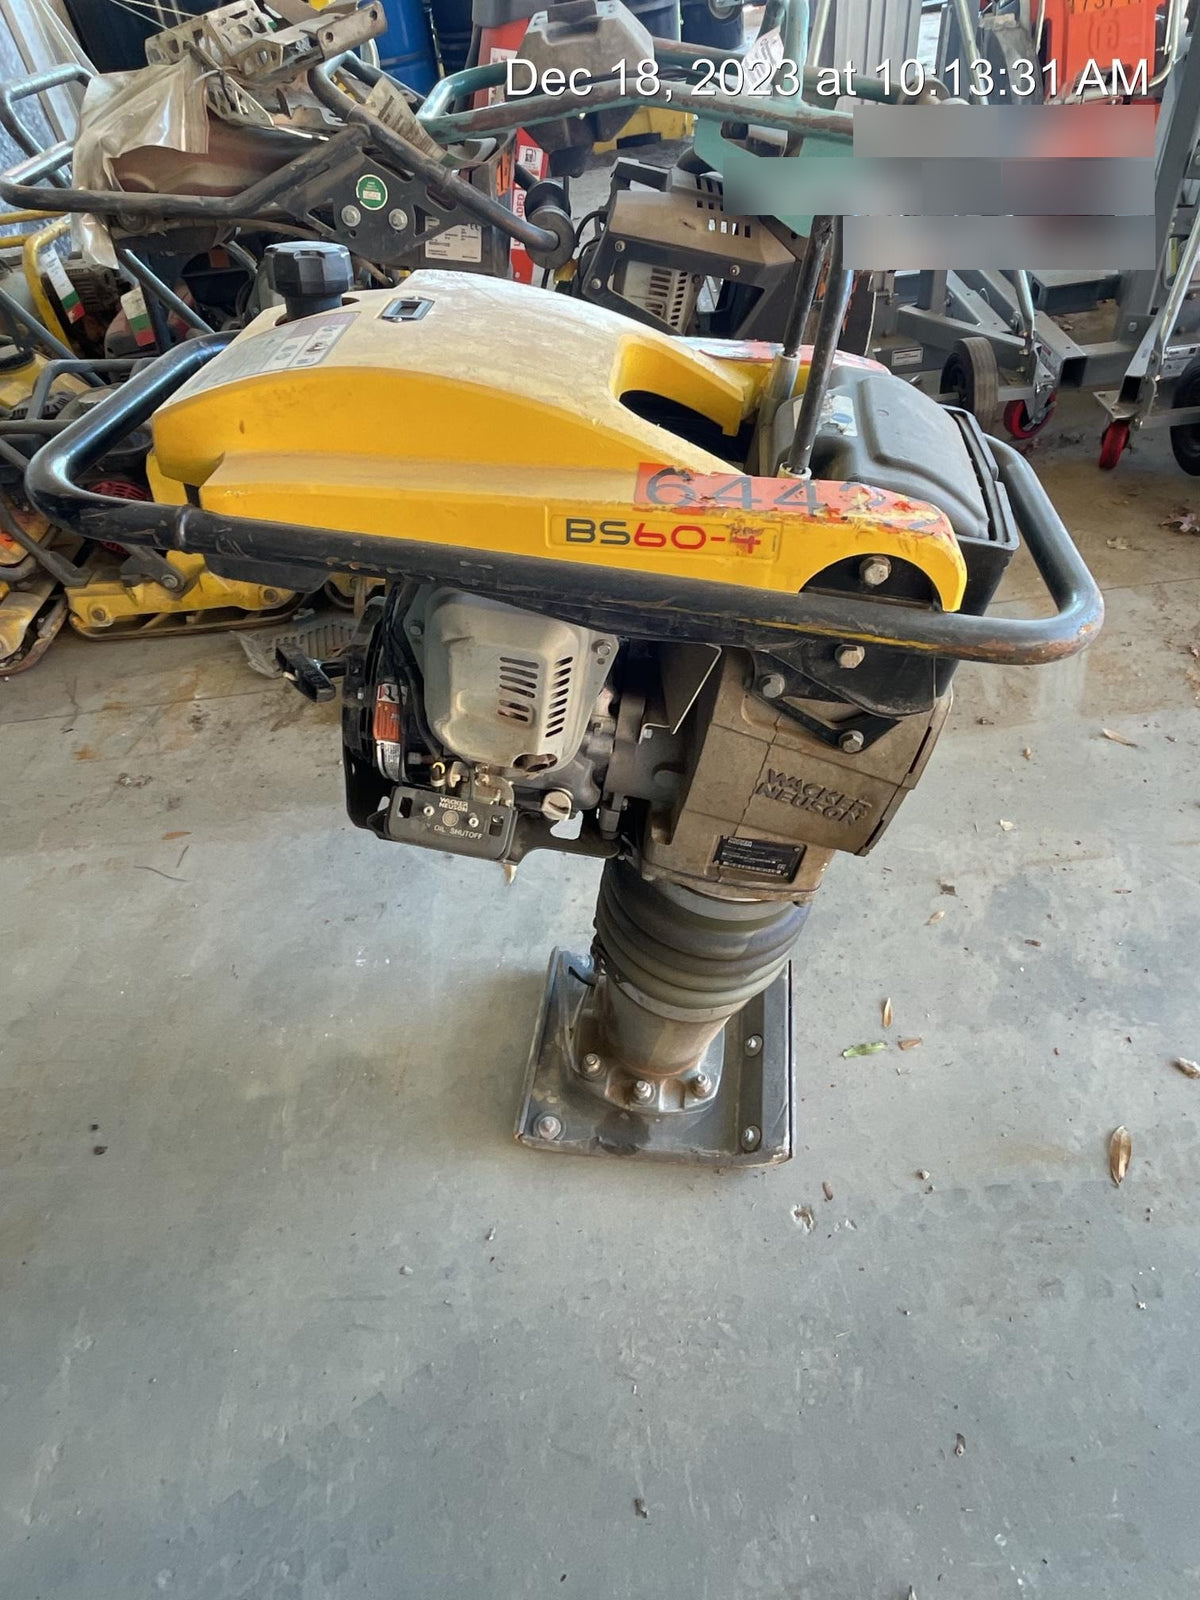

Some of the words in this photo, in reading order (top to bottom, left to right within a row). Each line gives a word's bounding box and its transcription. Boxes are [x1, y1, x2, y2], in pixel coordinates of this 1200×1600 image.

[566, 517, 762, 555] BS60-4
[755, 781, 868, 825] NEUSON
[767, 768, 873, 813] WACKER
[449, 827, 483, 840] SHUTOFF
